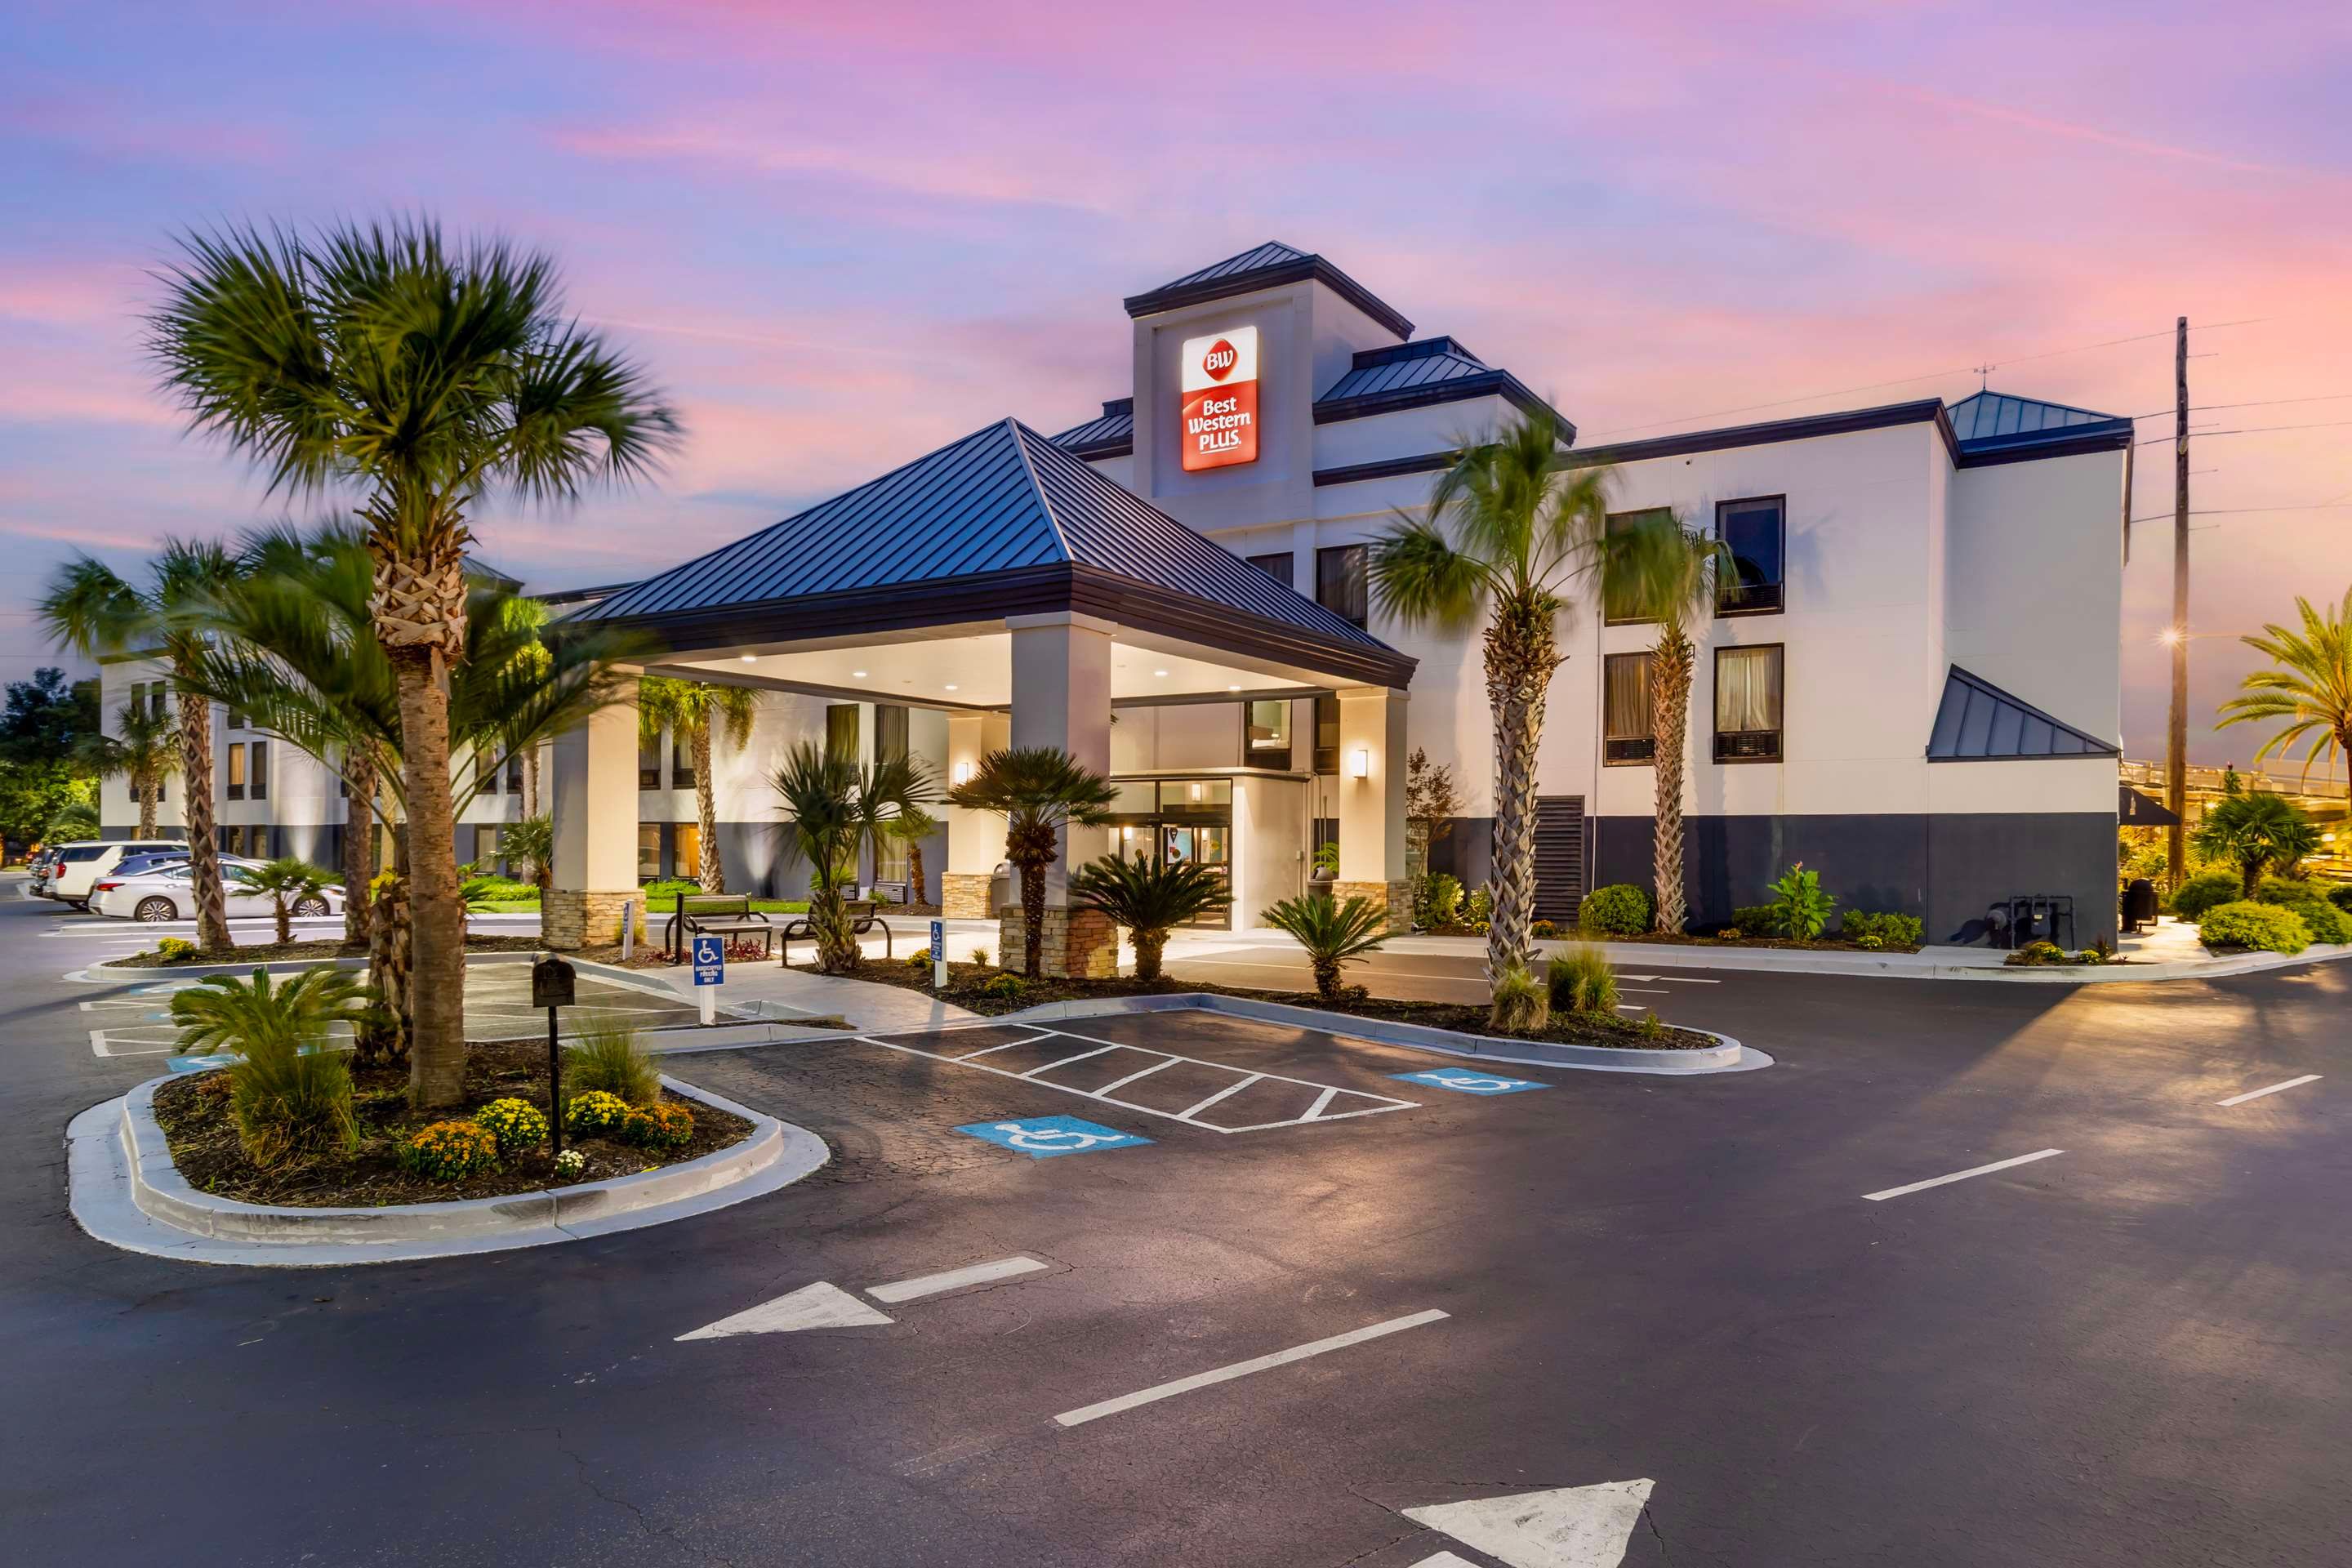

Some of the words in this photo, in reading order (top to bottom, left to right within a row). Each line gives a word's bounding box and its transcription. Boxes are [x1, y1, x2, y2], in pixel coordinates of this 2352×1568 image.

[1207, 350, 1233, 370] BW
[1203, 397, 1237, 416] Best
[1188, 412, 1251, 434] Western
